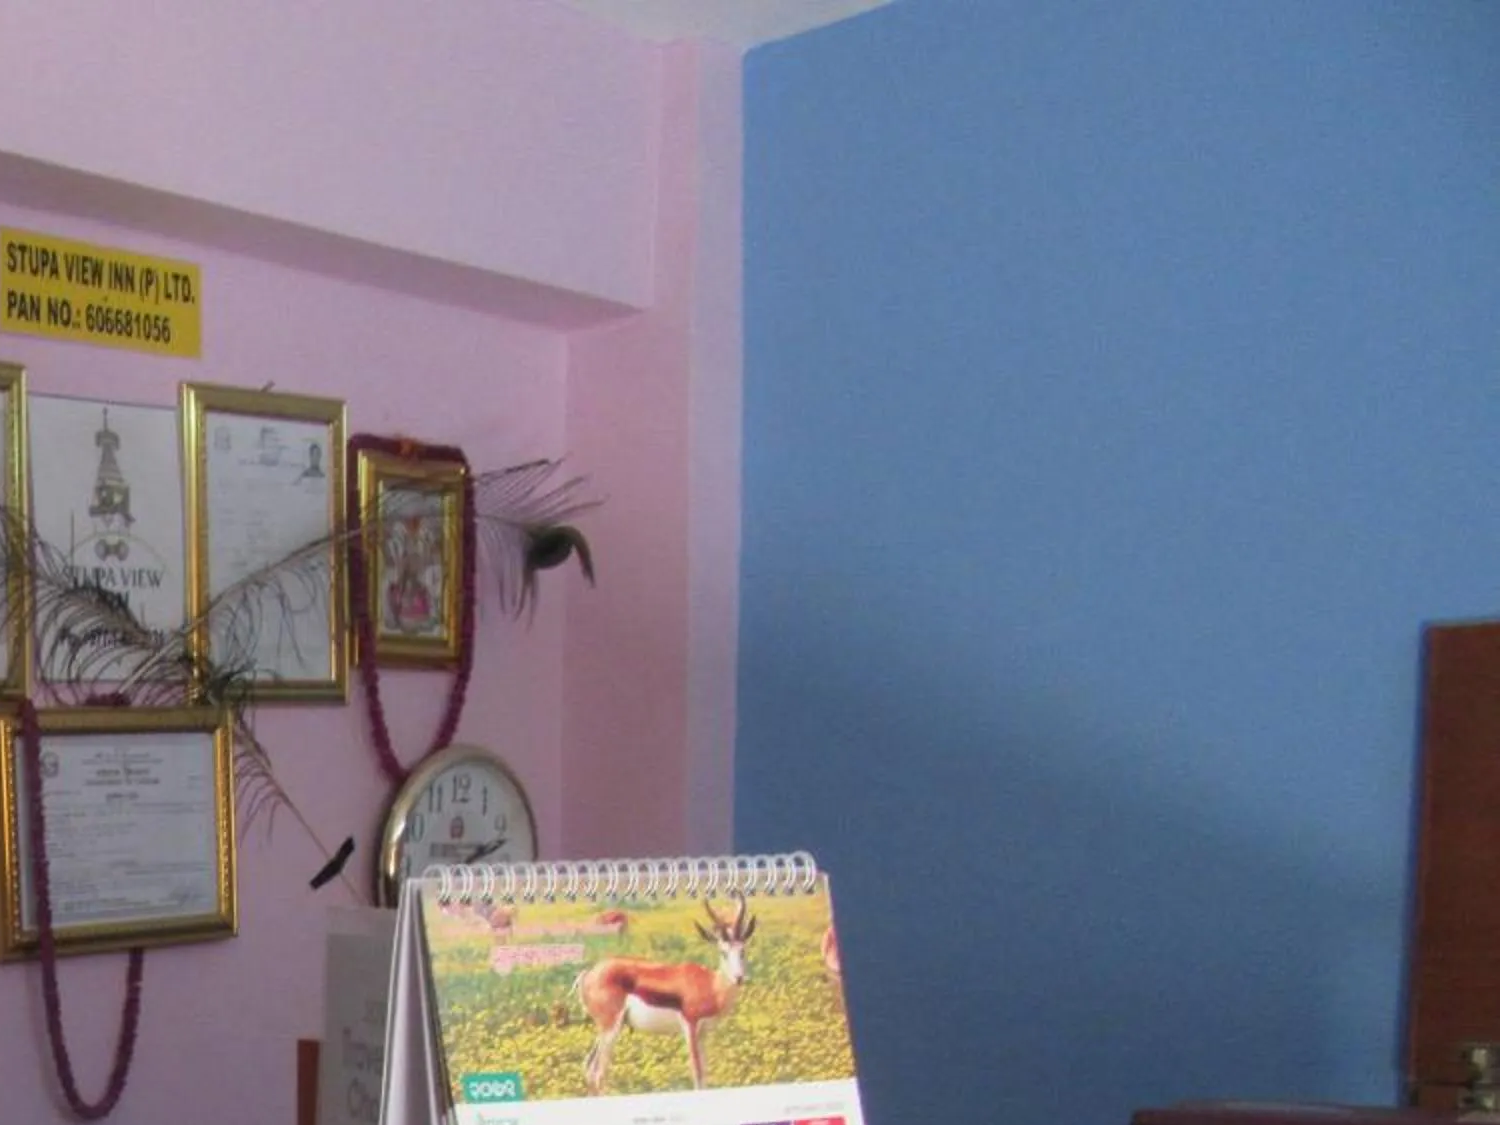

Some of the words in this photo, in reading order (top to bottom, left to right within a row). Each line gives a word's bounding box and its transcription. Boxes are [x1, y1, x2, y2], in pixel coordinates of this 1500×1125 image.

[7, 241, 59, 280] STUPA
[64, 252, 103, 288] VIEW
[109, 262, 135, 293] INN
[139, 267, 160, 304] (P)
[164, 272, 195, 304] LTD.
[7, 289, 41, 323] PAN
[86, 303, 171, 344] 606681056
[120, 568, 164, 588] VIEW
[451, 774, 471, 803] 12
